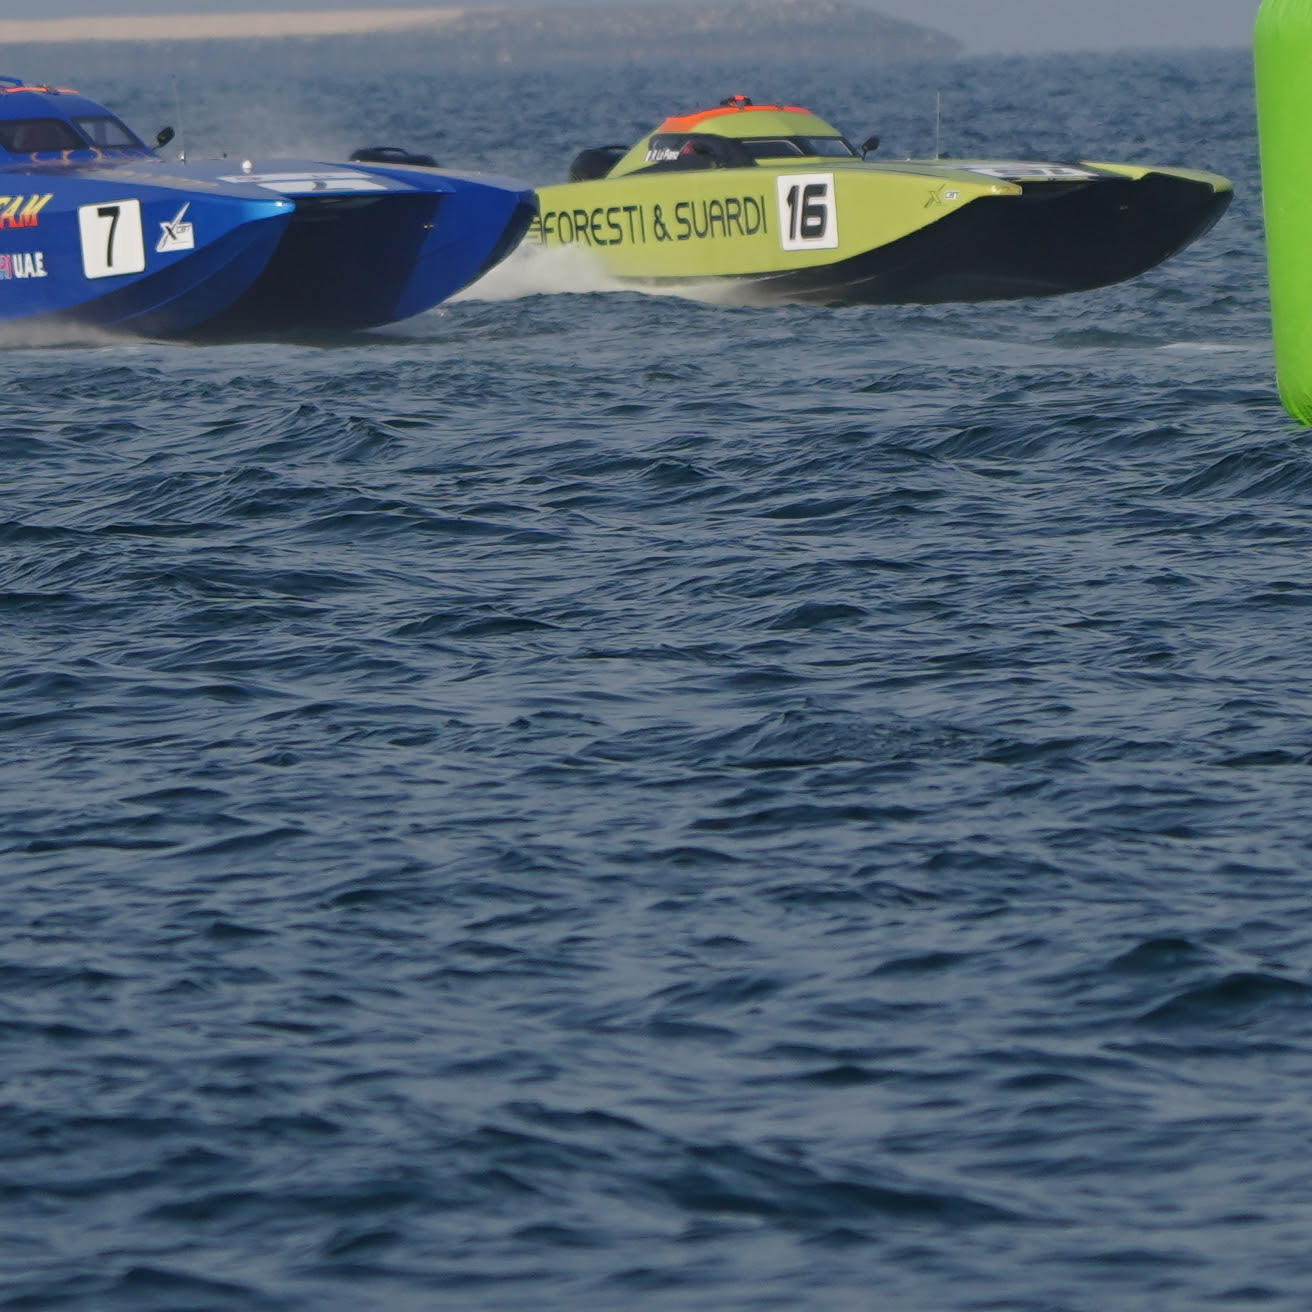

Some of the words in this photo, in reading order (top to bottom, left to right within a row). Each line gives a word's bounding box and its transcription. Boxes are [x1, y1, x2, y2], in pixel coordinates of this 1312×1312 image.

[97, 205, 120, 268] 7
[543, 204, 646, 248] FORESTI
[653, 203, 674, 242] &
[674, 195, 768, 241] SUARDI
[786, 183, 828, 241] 16
